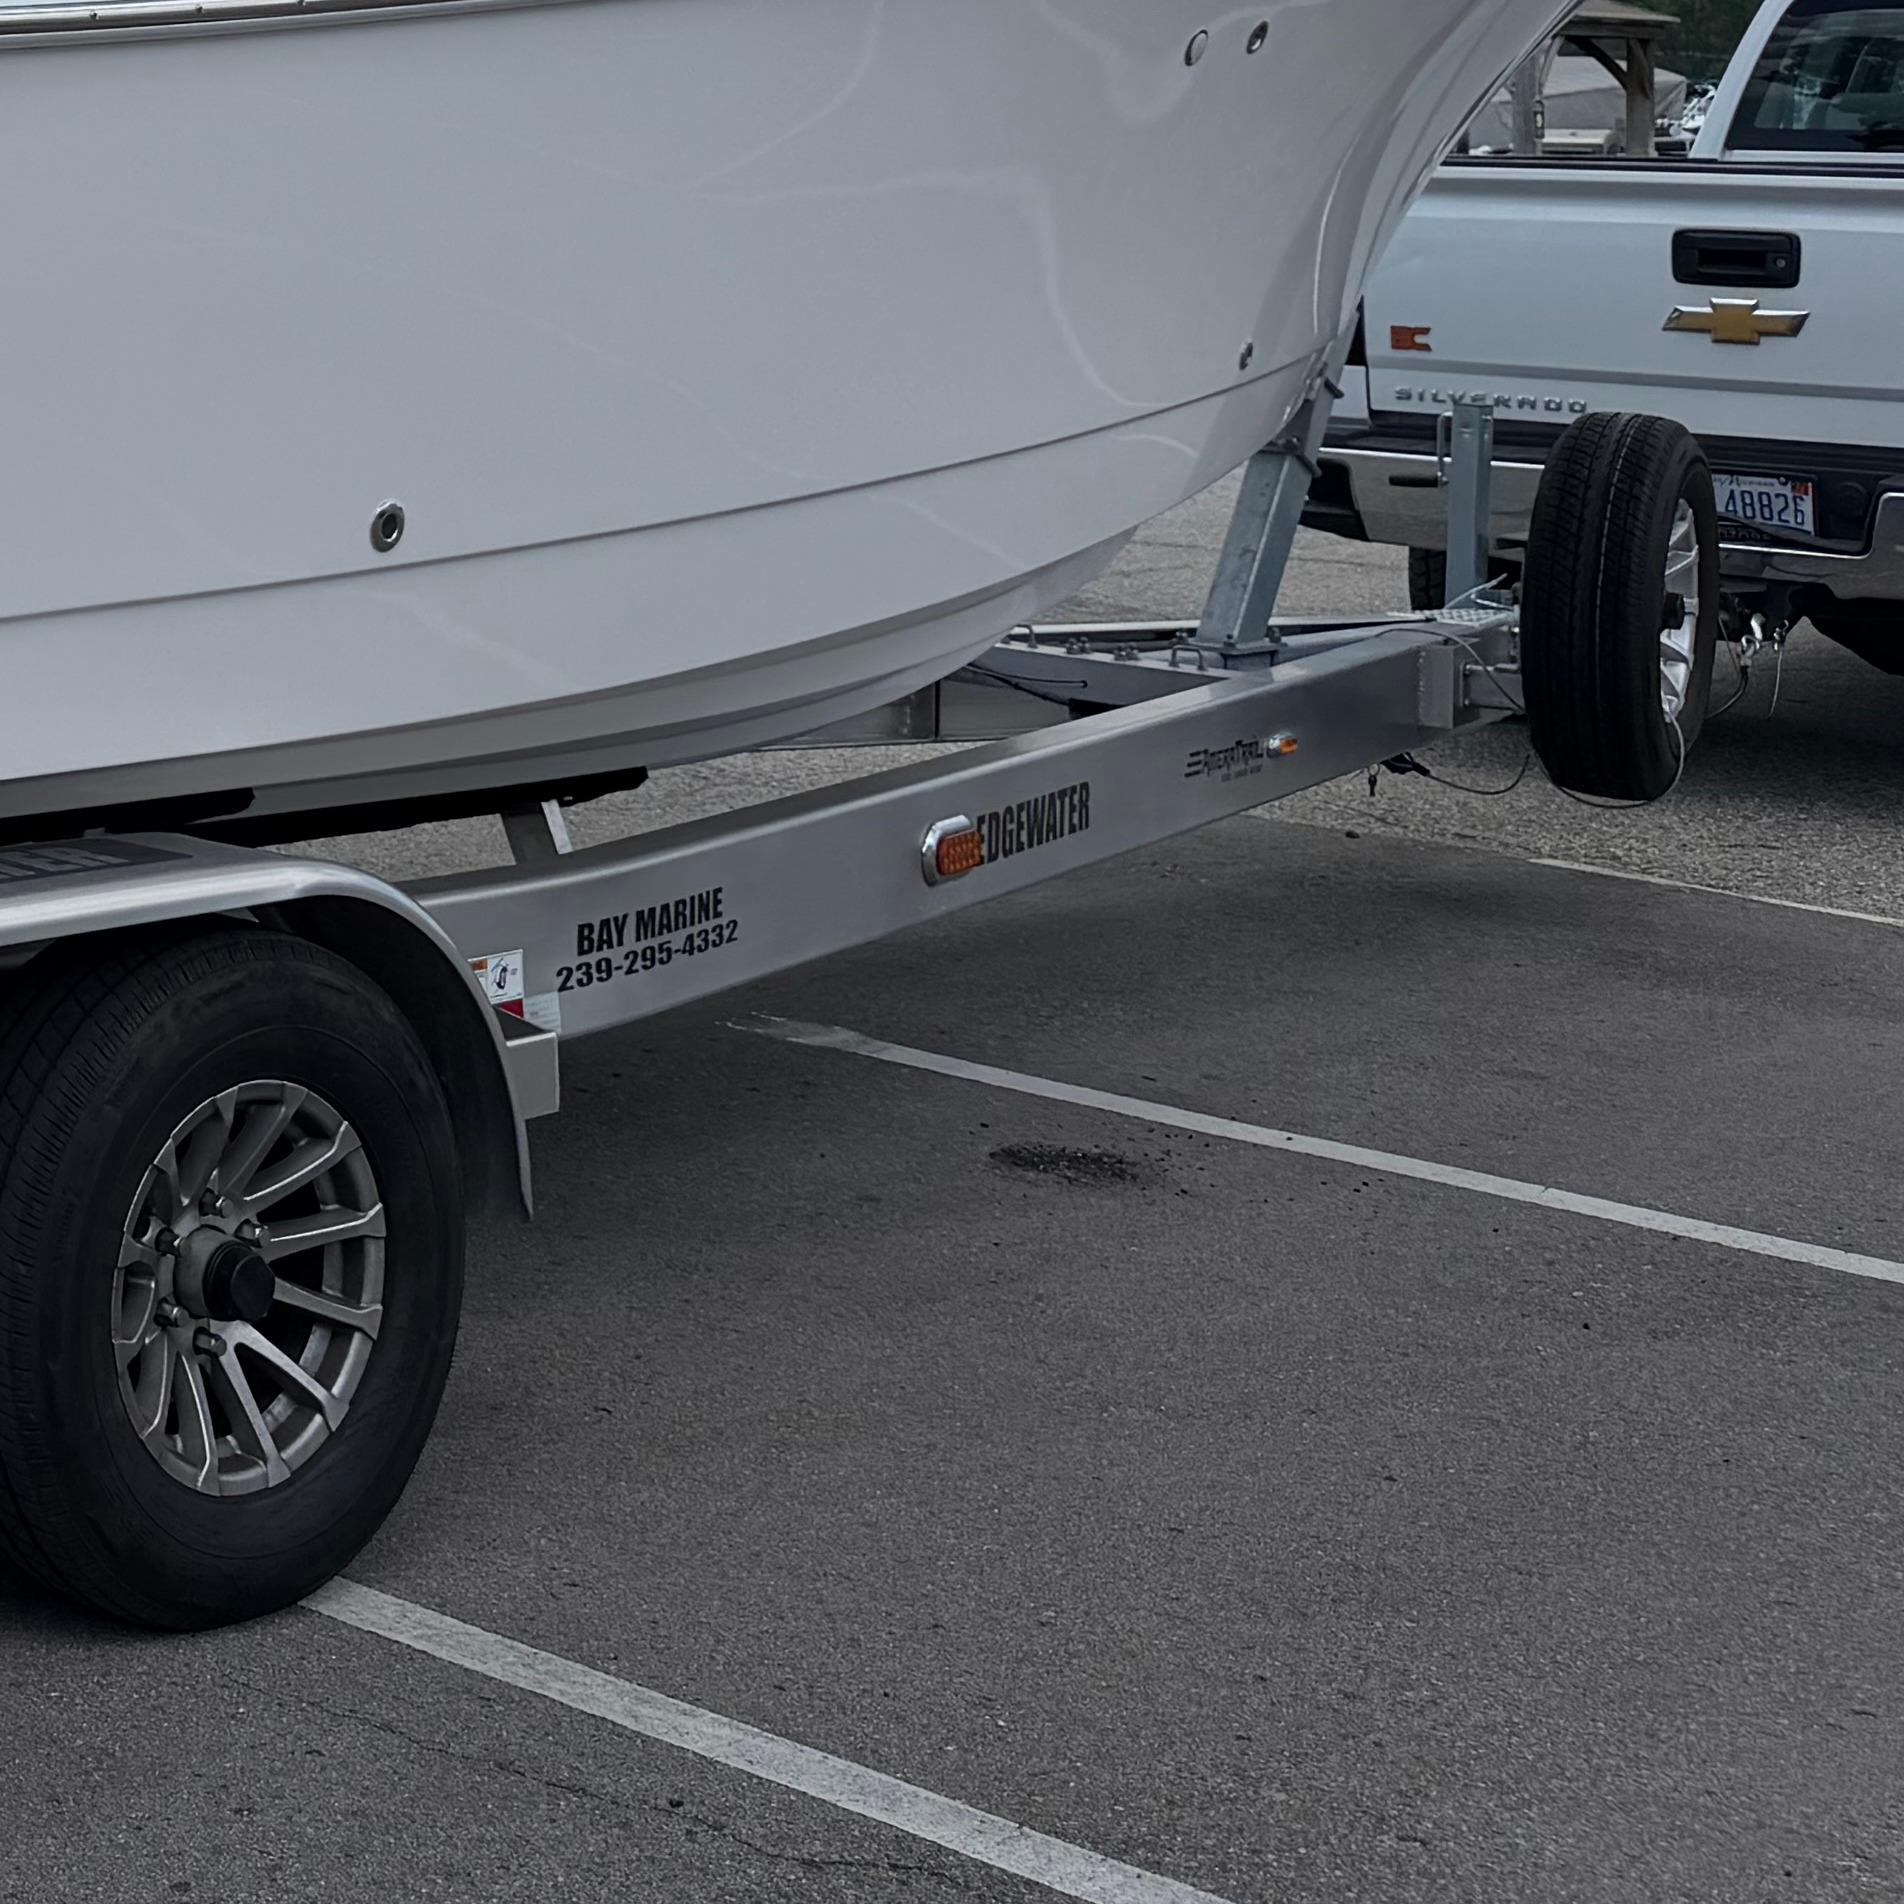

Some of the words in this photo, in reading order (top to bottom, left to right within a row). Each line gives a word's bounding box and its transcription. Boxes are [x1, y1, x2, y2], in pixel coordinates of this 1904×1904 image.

[1394, 386, 1588, 414] SILVERADO
[976, 781, 1090, 866] EDGEWATER
[556, 919, 739, 993] 239-295-4332
[577, 913, 629, 957] BAY
[635, 886, 723, 942] MARINE
